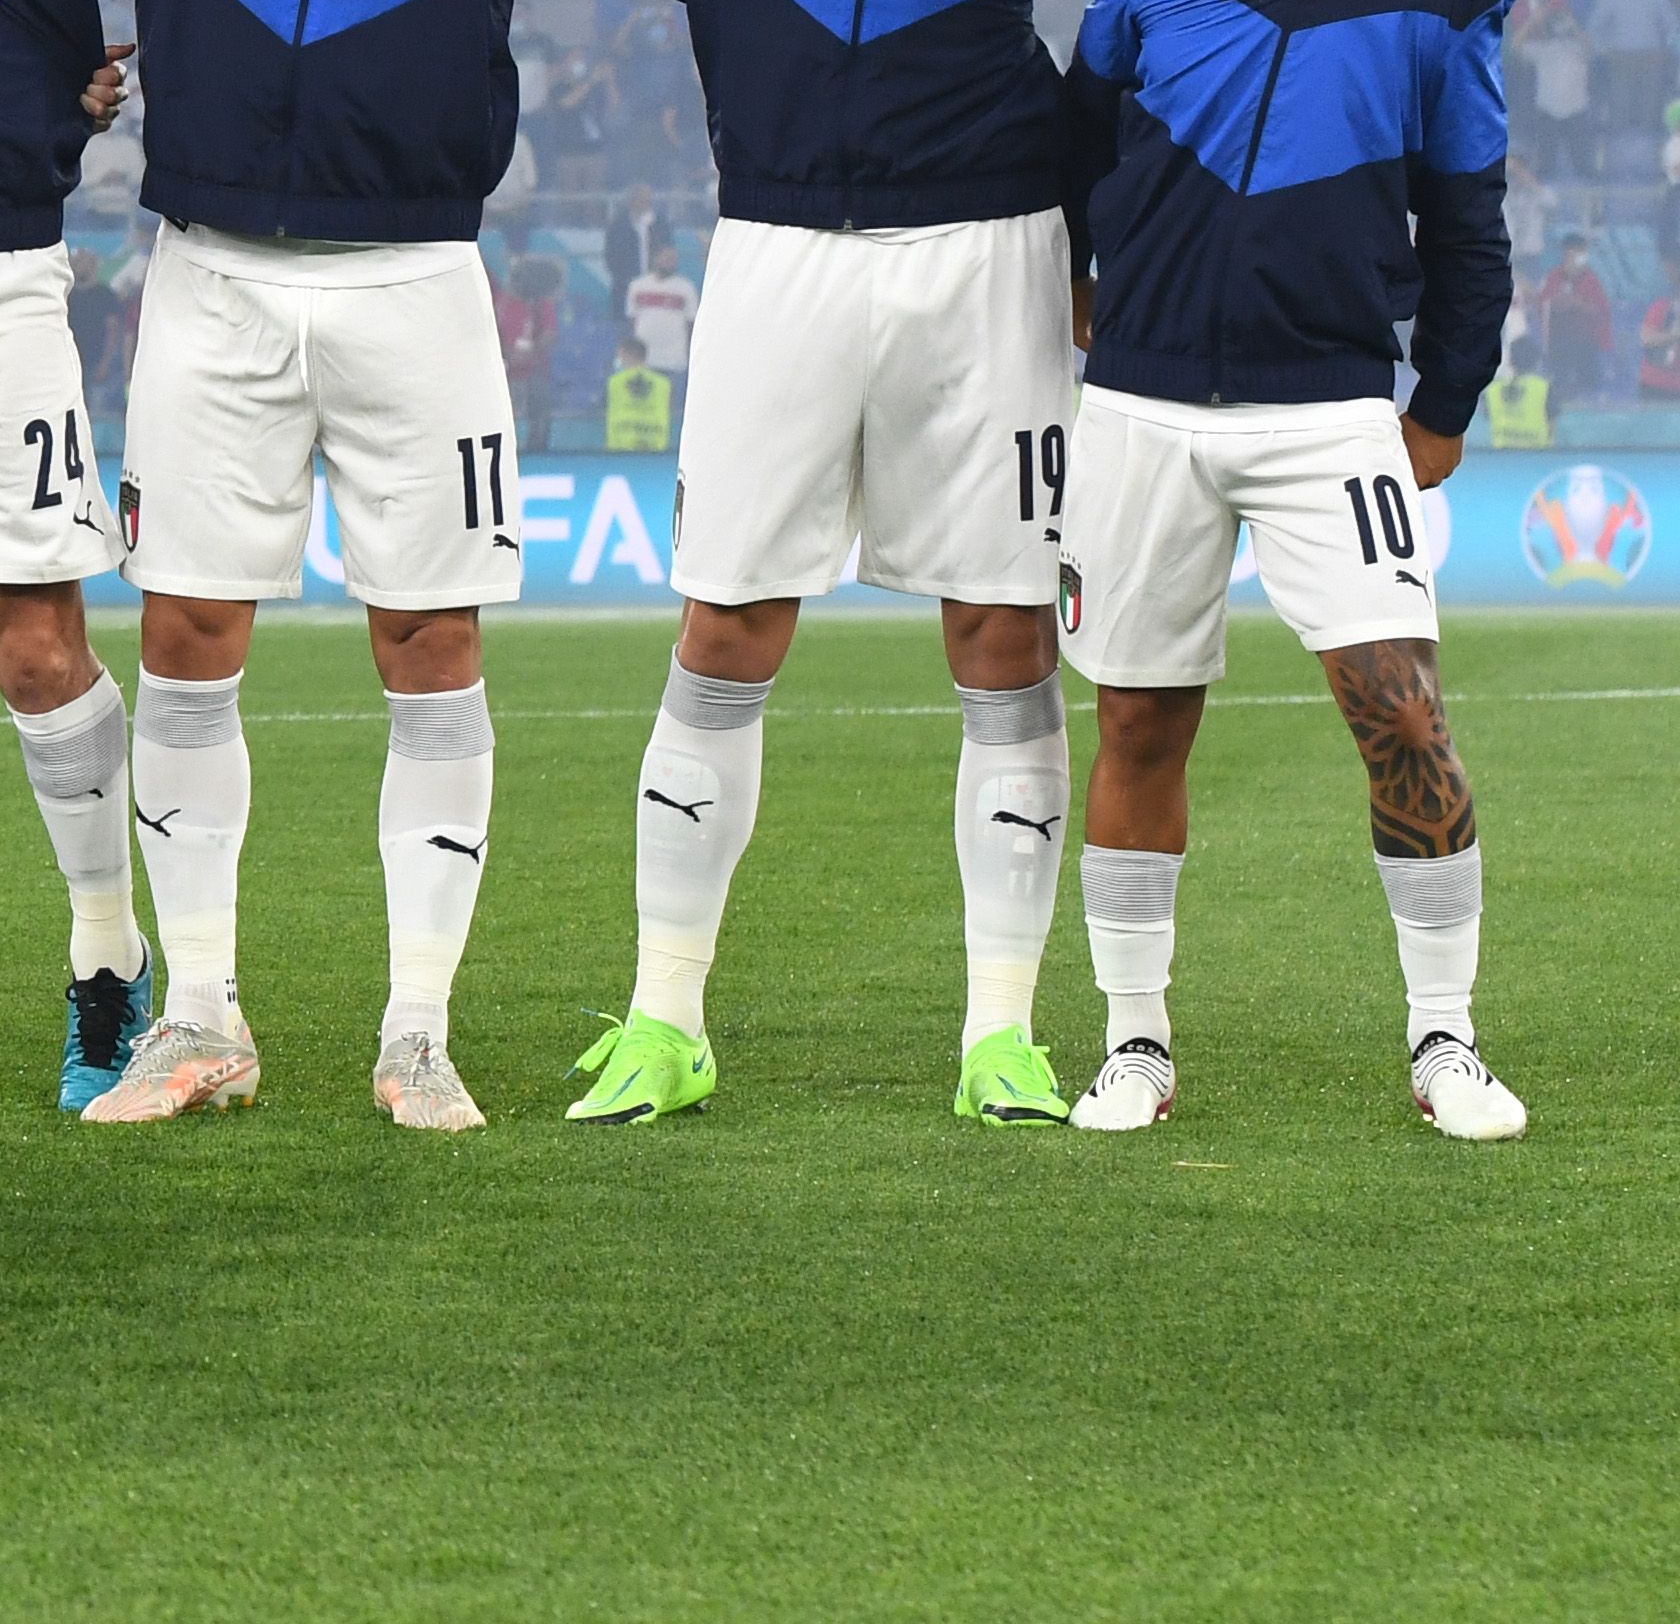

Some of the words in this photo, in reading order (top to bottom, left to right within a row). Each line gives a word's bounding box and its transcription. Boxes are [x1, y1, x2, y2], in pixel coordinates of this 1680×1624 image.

[23, 408, 83, 511] 24
[457, 432, 503, 531] 17
[1014, 425, 1066, 522] 19
[1343, 474, 1415, 566] 10
